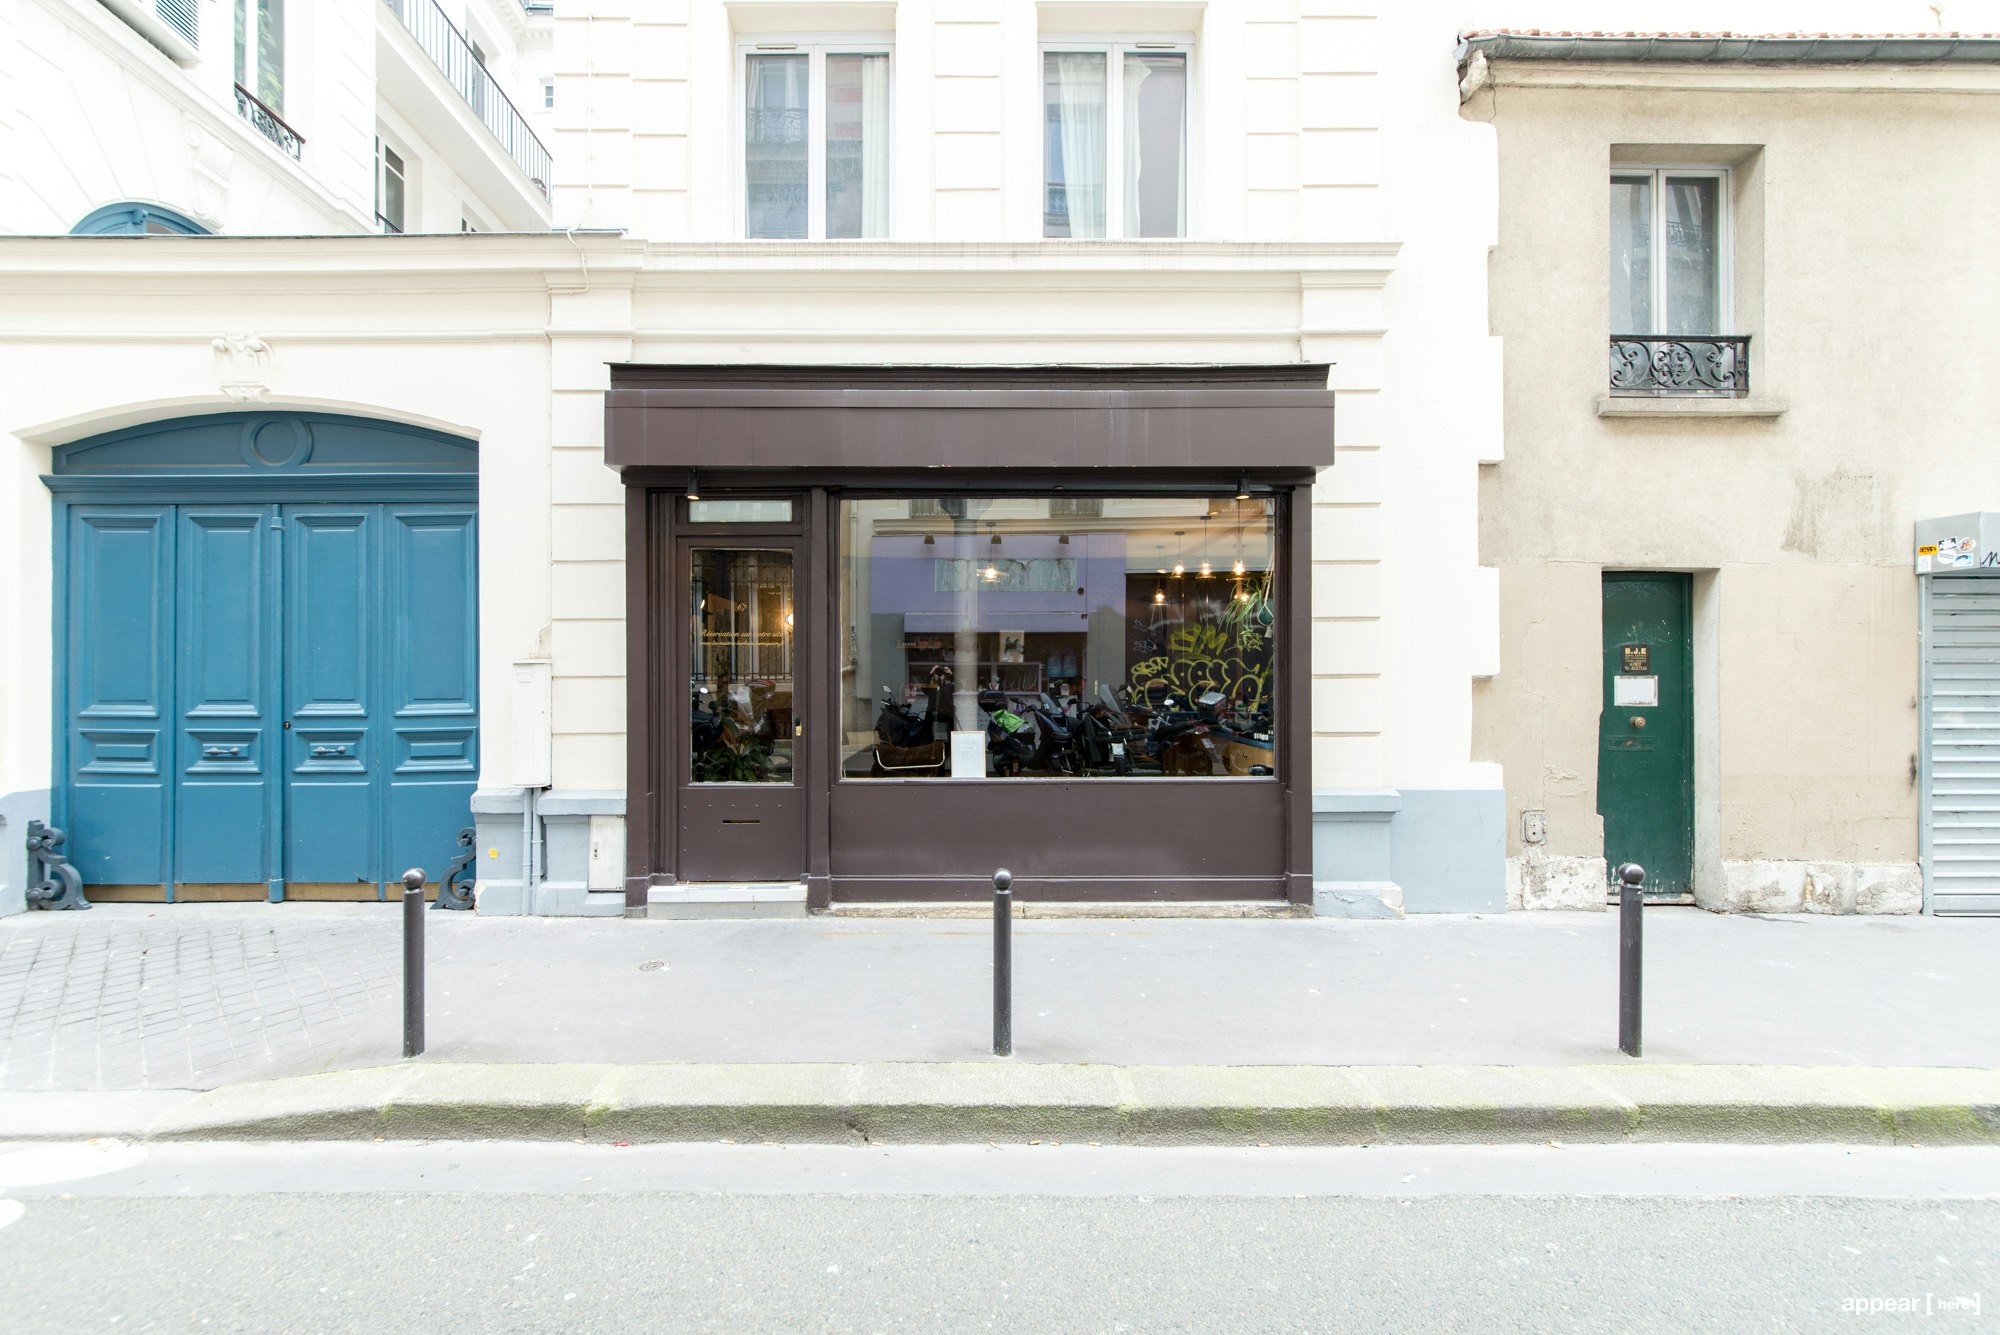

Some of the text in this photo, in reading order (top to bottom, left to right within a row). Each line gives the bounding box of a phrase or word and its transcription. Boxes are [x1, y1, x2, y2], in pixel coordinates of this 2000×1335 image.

[701, 628, 740, 638] Réservation
[753, 630, 772, 638] notre
[772, 630, 784, 638] site
